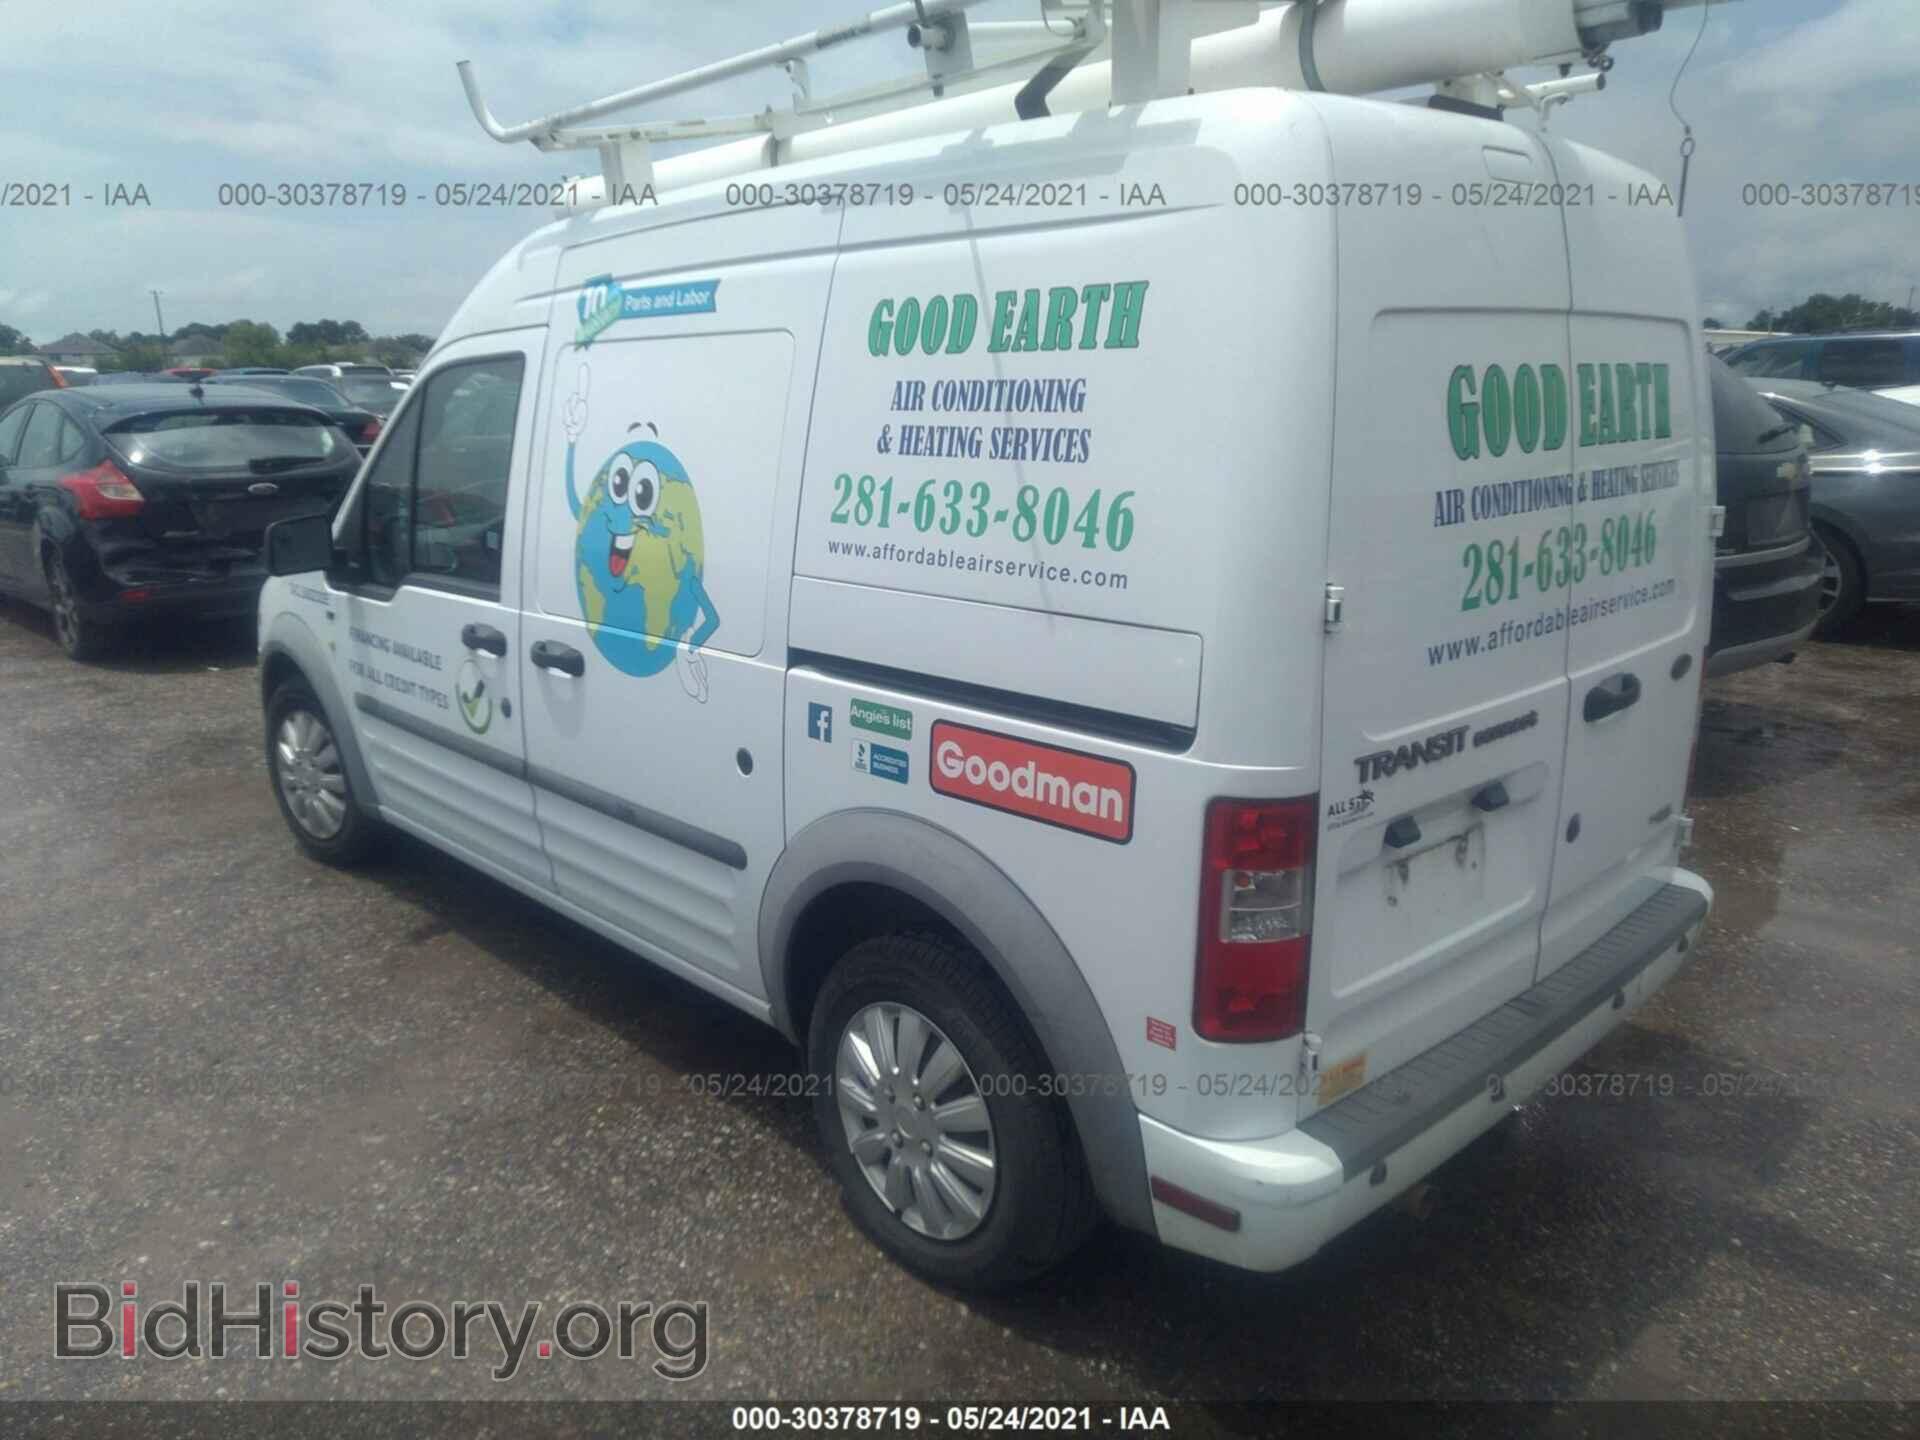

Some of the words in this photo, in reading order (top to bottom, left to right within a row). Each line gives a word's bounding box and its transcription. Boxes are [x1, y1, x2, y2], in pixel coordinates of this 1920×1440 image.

[623, 294, 650, 312] Parts
[653, 289, 674, 309] and
[676, 288, 710, 307] Labor
[868, 293, 978, 357] GOOD
[987, 280, 1150, 353] EARTH
[890, 380, 925, 412] AIR
[931, 377, 1087, 414] CONDITIONING
[1447, 363, 1569, 461] GOOD
[1577, 362, 1672, 448] EARTH
[876, 423, 893, 455] &
[898, 424, 983, 459] HEATING
[988, 427, 1092, 463] SERVICES
[830, 473, 1137, 552] 281-633-8046
[1434, 488, 1466, 528] AIR
[1471, 473, 1574, 522] CONDITIONING
[1591, 465, 1639, 502] HEATING
[827, 538, 1129, 590] www.affordableairservice.com
[1461, 508, 1657, 612] 281-633-8046
[1427, 577, 1676, 667] www.affordableairservice.com
[936, 739, 1124, 823] Goodman
[1354, 724, 1471, 784] TRANSIT
